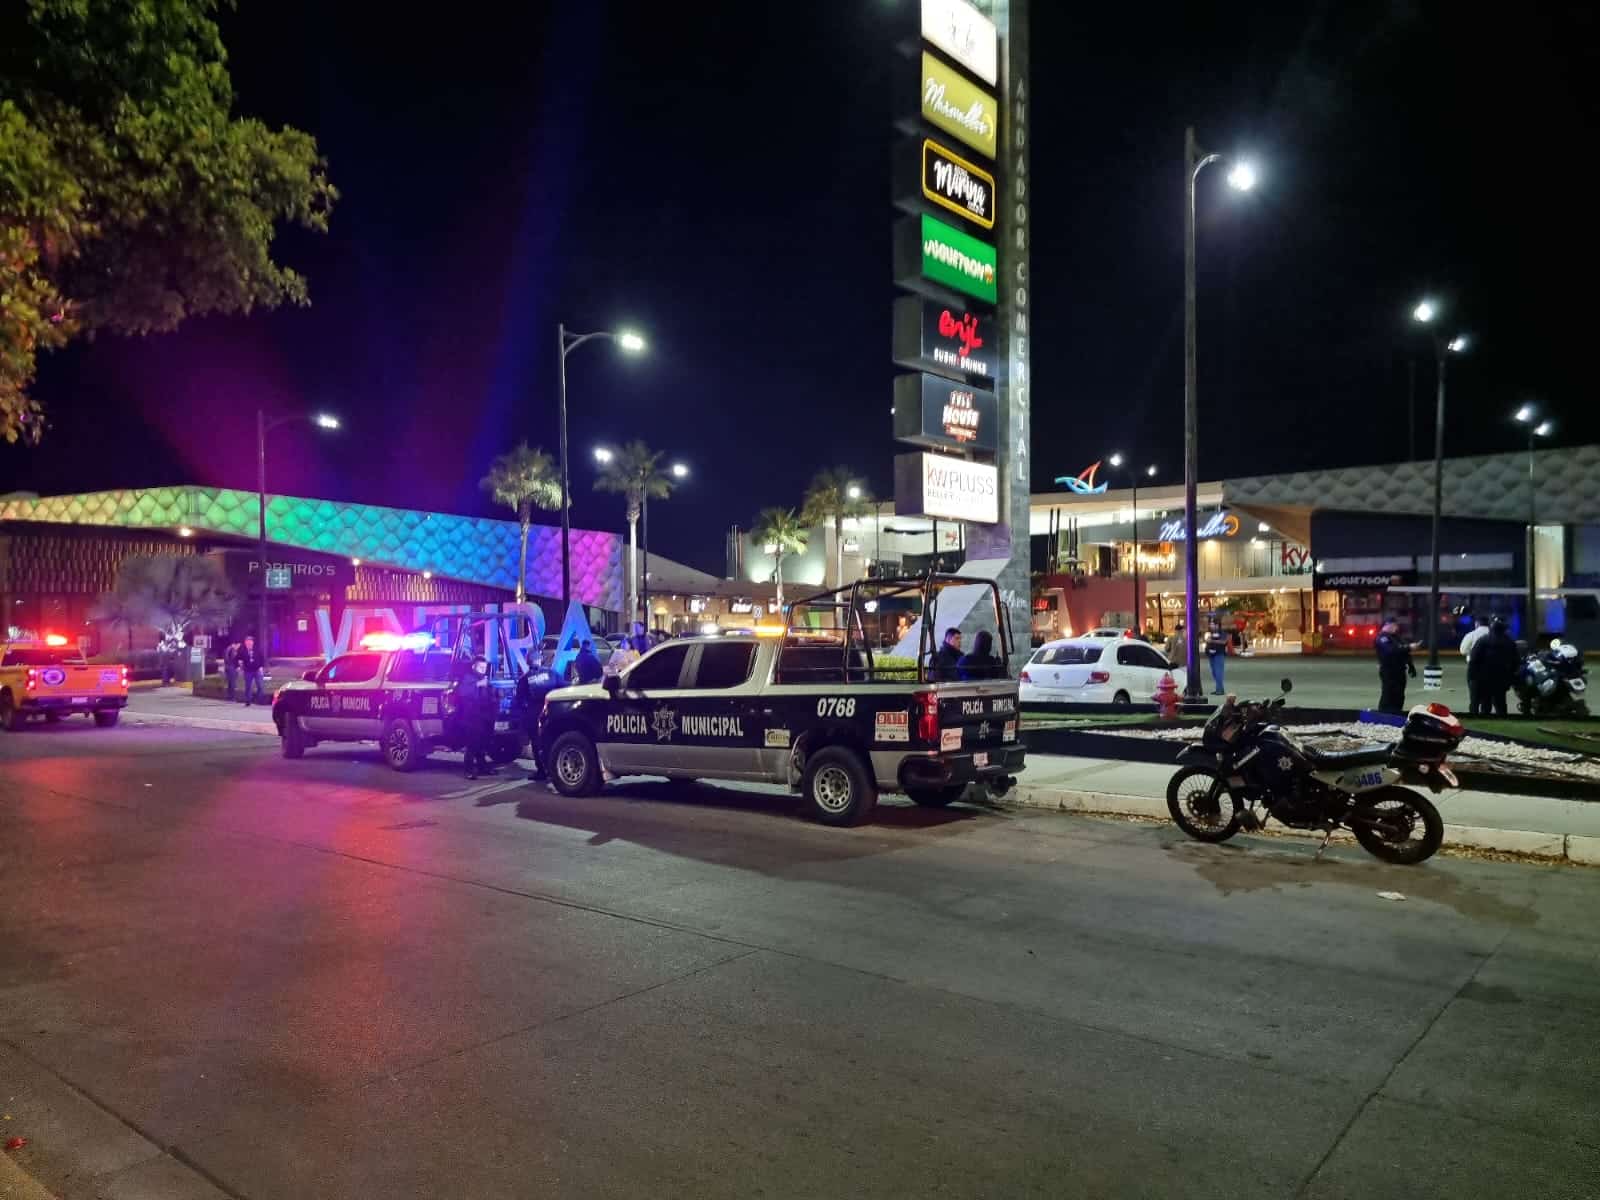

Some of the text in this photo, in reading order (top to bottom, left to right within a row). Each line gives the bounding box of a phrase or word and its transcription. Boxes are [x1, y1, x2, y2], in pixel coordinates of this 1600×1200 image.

[1015, 261, 1026, 481] COMERCIAL
[816, 697, 856, 717] 0768
[962, 700, 984, 715] POLICIA
[607, 714, 744, 737] POLICIA MUNICIPAL
